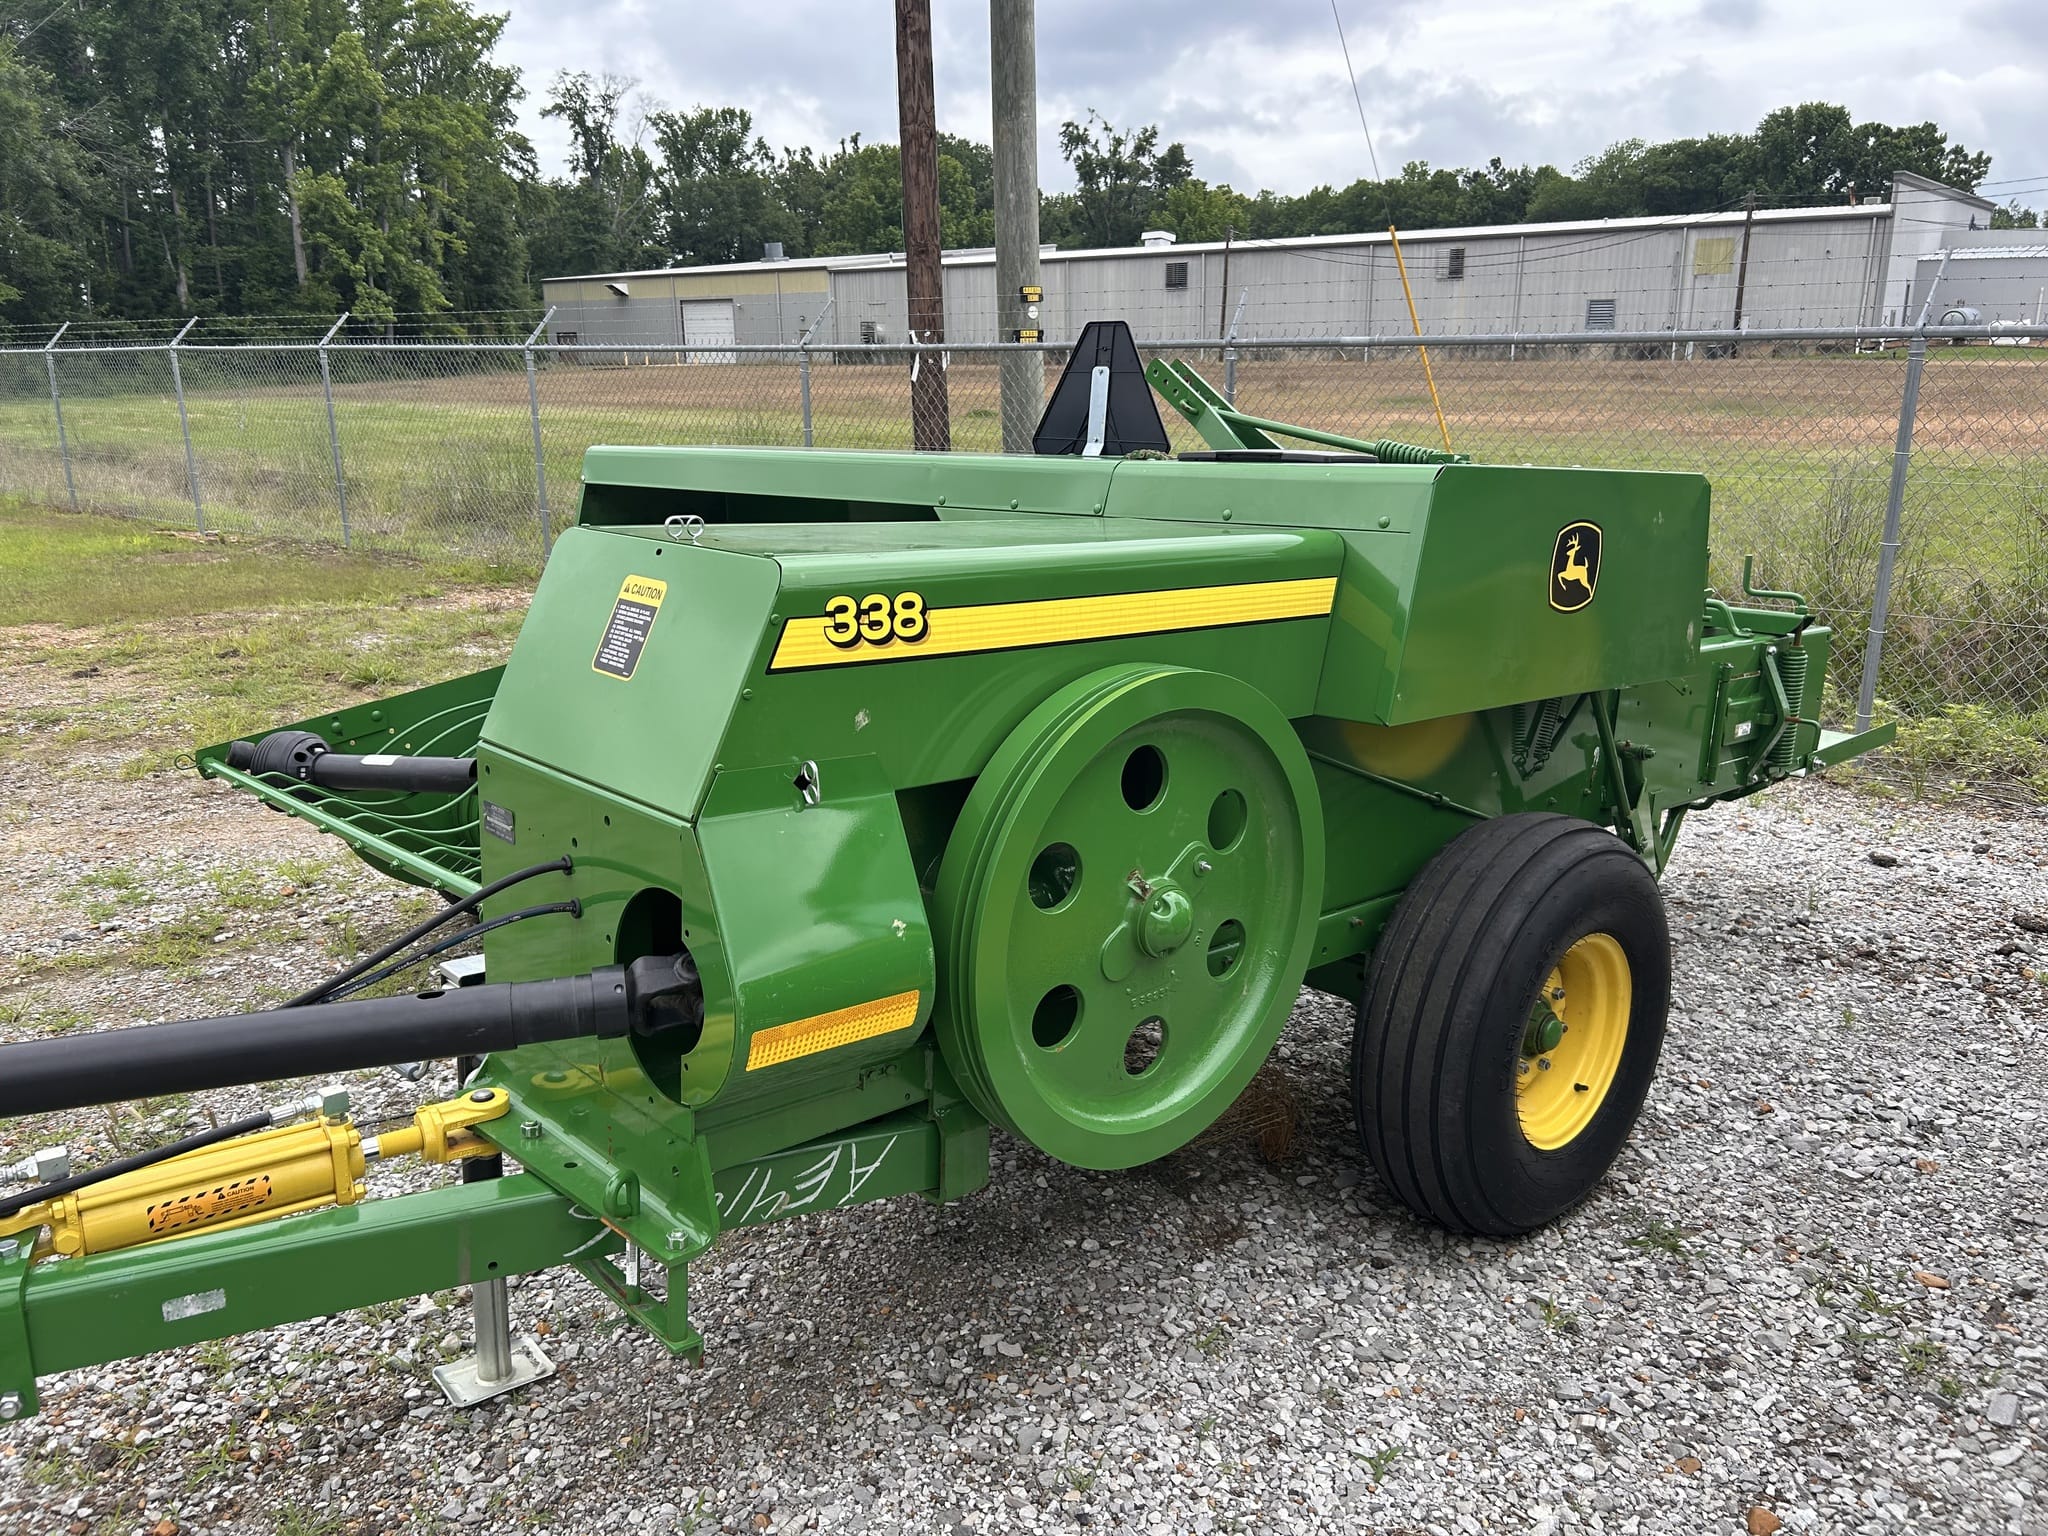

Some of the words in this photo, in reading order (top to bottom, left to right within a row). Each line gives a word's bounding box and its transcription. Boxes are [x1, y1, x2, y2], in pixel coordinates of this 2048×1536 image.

[631, 583, 663, 600] CAUTION
[824, 591, 929, 649] 338
[227, 1186, 254, 1197] CAUTION
